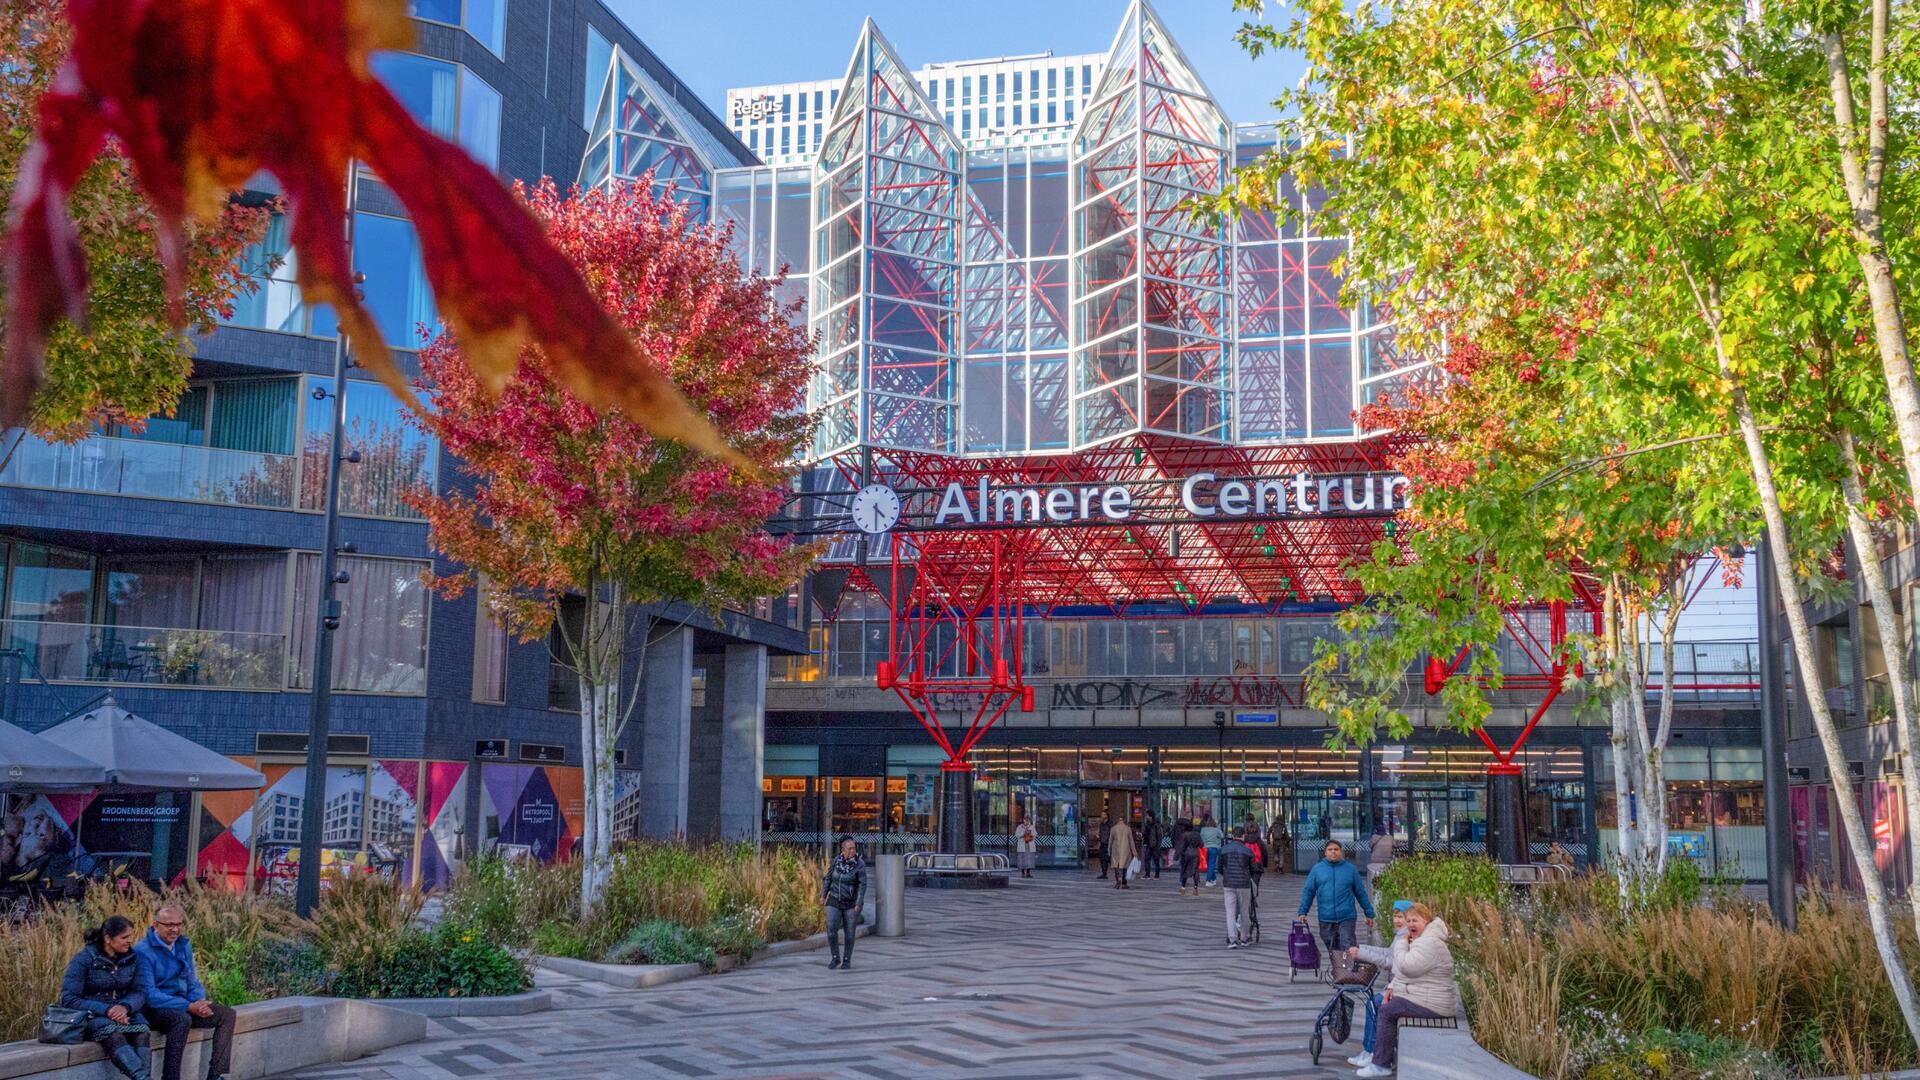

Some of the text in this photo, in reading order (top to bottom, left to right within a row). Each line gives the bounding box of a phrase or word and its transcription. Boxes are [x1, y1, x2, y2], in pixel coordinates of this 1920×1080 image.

[733, 99, 783, 120] Regus
[934, 477, 1132, 524] Almere
[873, 629, 880, 639] 2
